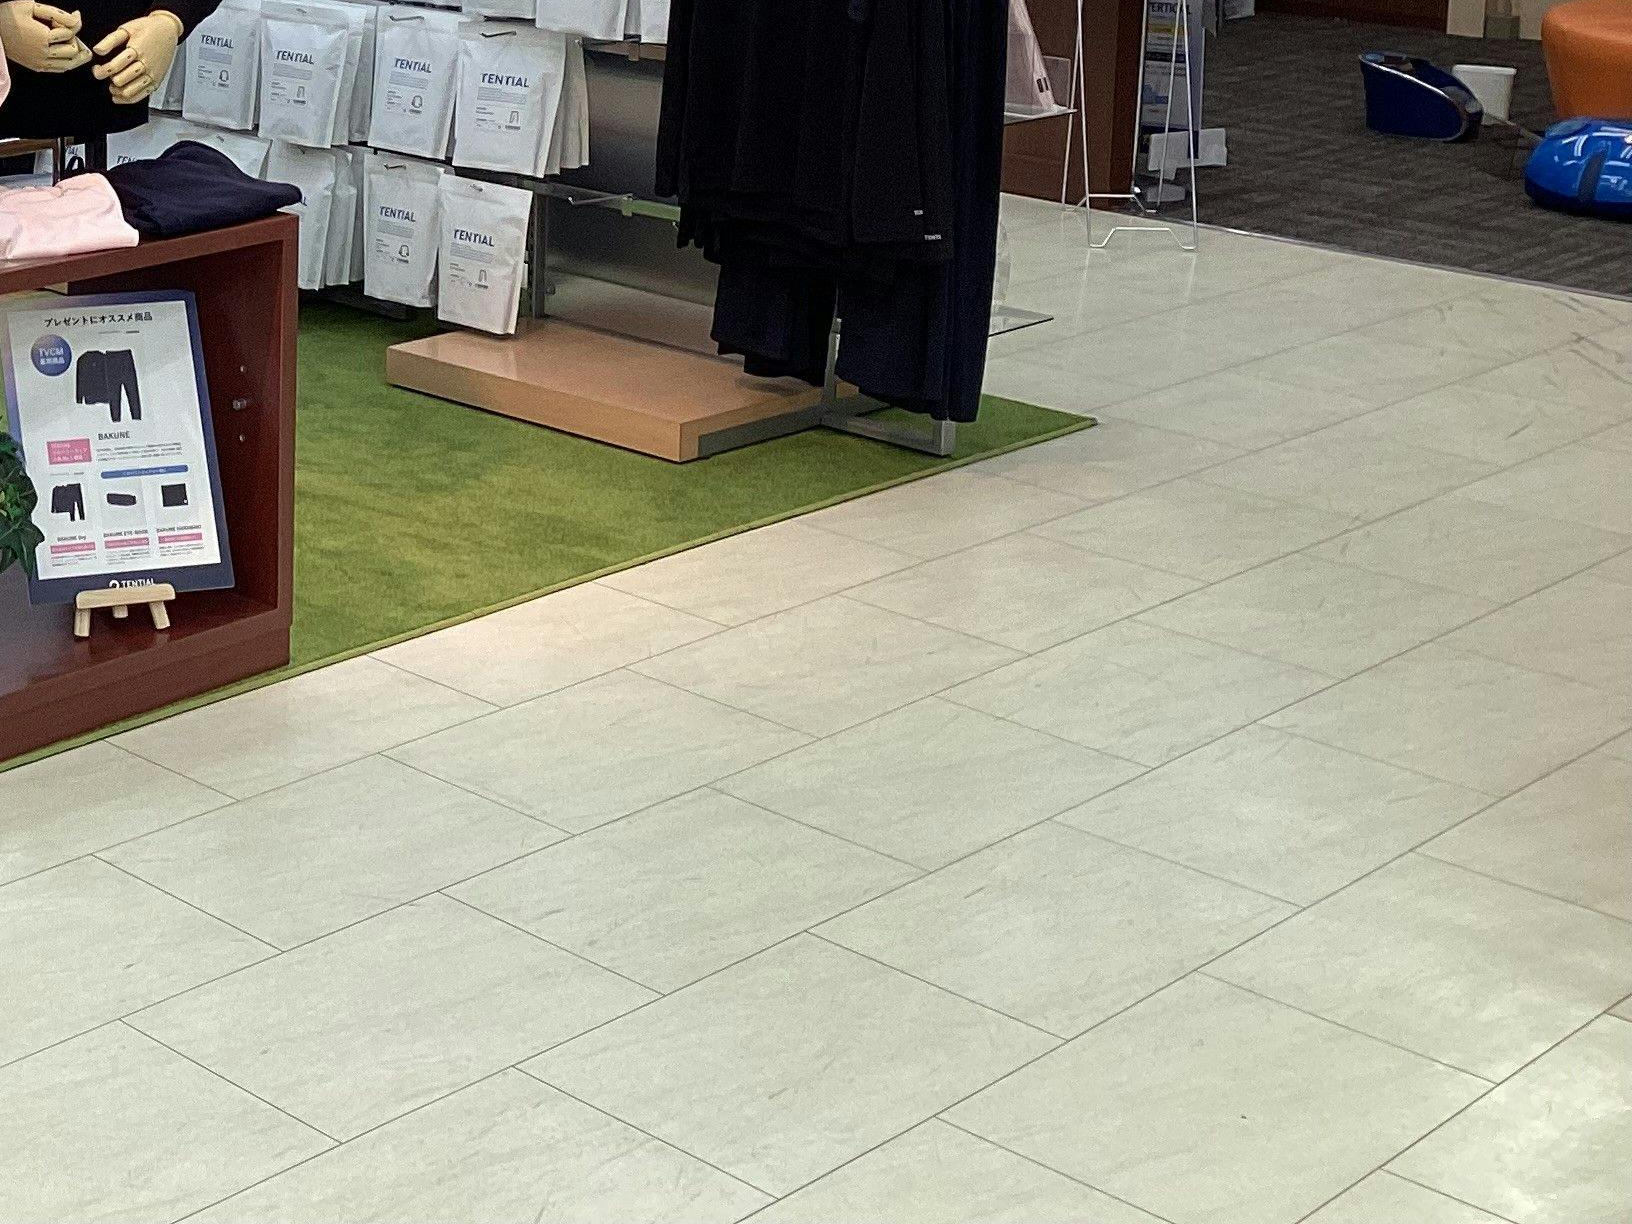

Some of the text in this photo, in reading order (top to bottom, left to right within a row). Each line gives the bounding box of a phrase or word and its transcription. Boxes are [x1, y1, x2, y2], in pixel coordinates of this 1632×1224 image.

[201, 34, 235, 49] TENTIAL
[276, 49, 315, 65] TENTIAL
[394, 57, 432, 74] TENTIAL
[481, 72, 530, 89] TENTIAL
[379, 205, 416, 223] TENTIAL
[453, 228, 495, 248] TENTIAL
[44, 311, 153, 328] プレゼントにオススメ商品
[98, 431, 130, 441] BAKUNE
